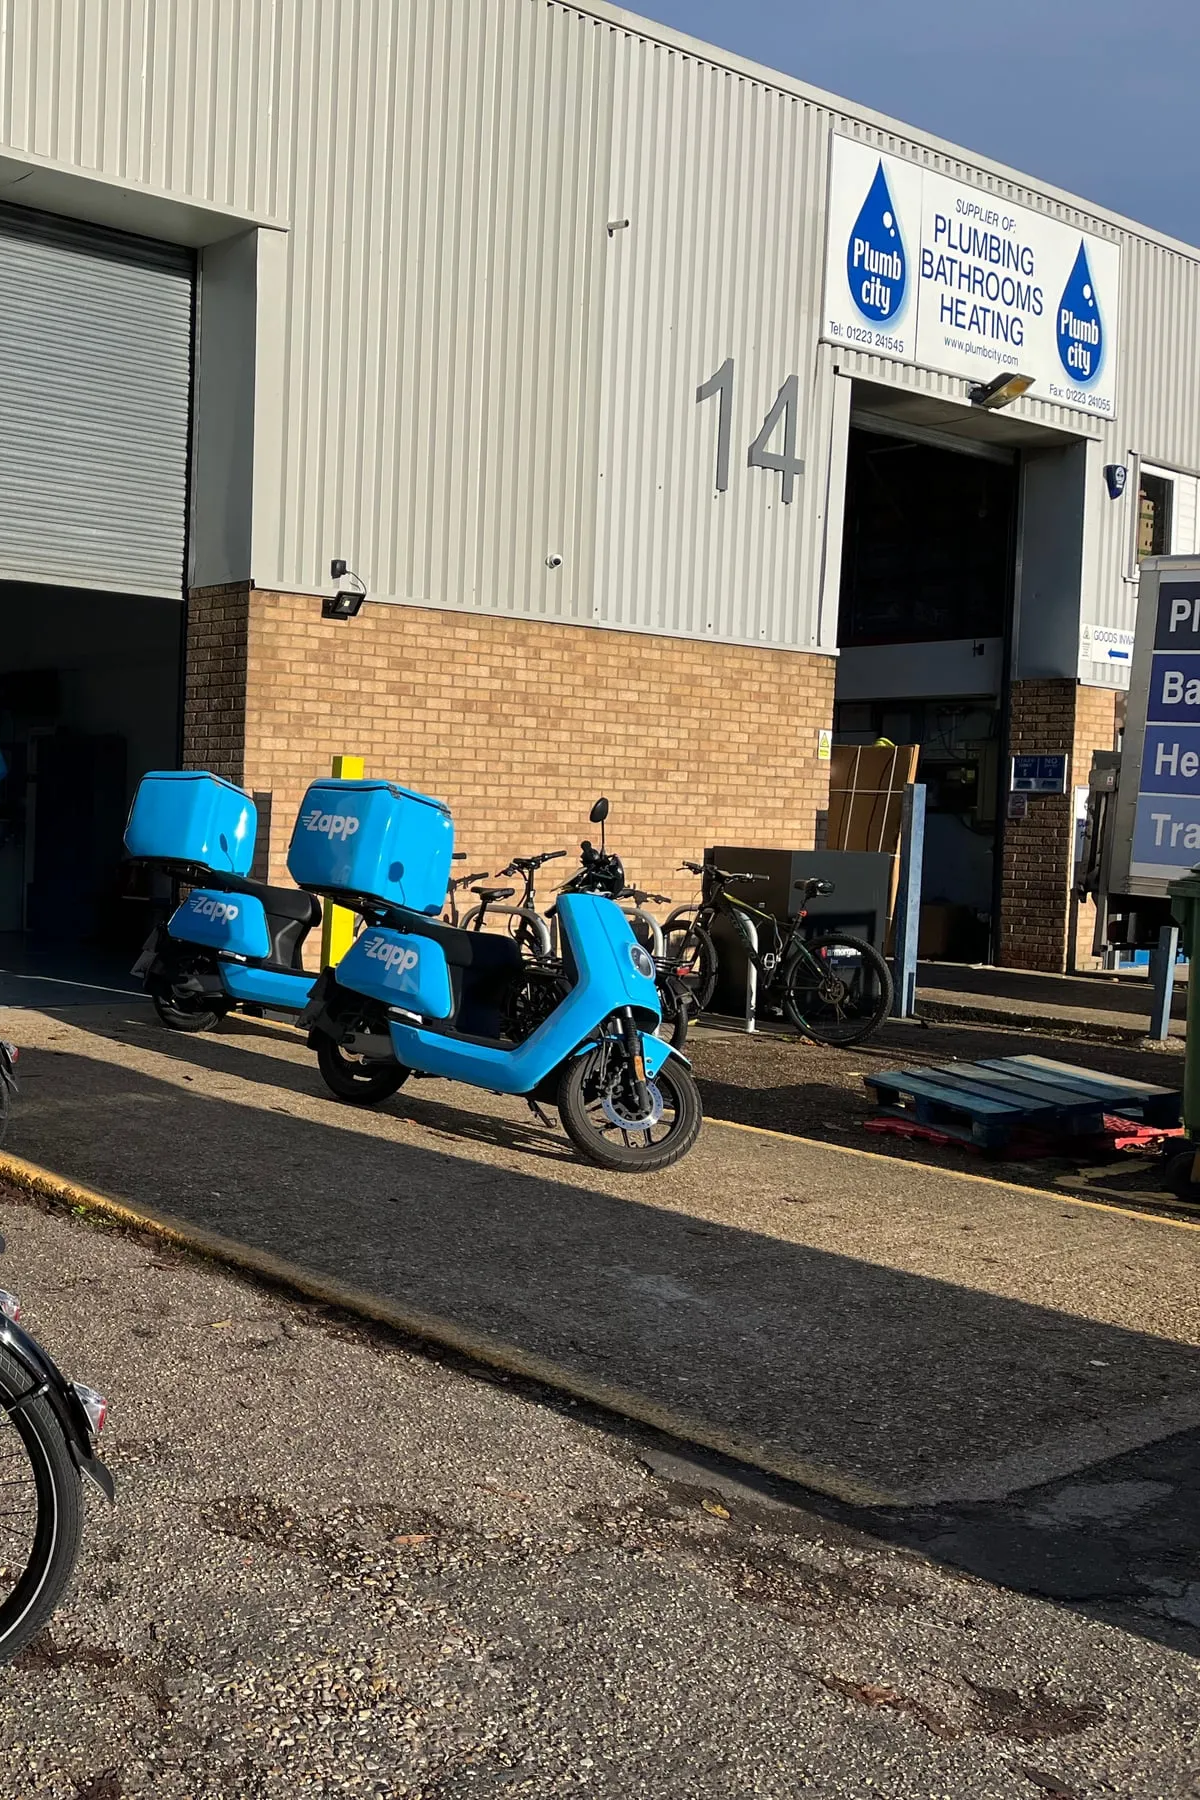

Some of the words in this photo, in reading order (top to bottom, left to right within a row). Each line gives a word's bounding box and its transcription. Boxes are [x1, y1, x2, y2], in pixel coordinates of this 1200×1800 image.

[956, 198, 999, 227] SUPPLIER
[1002, 216, 1016, 233] OF:
[853, 237, 901, 281] Plumb
[935, 213, 1034, 277] PLUMBING
[861, 275, 891, 315] city
[921, 247, 1043, 316] BATHROOMS
[829, 321, 843, 337] Tel:
[847, 326, 872, 345] 01223
[875, 333, 904, 353] 241545
[940, 293, 1024, 347] HEATING
[1060, 308, 1099, 345] Plumb
[944, 336, 1019, 366] www.plumbcity.com
[1067, 341, 1091, 376] city
[1049, 384, 1064, 398] Fax:
[1066, 388, 1086, 404] 01223
[696, 357, 805, 505] 14
[1094, 630, 1118, 644] GOODS
[305, 810, 359, 841] Zapp
[192, 896, 239, 925] Zapp
[365, 936, 419, 975] Zapp
